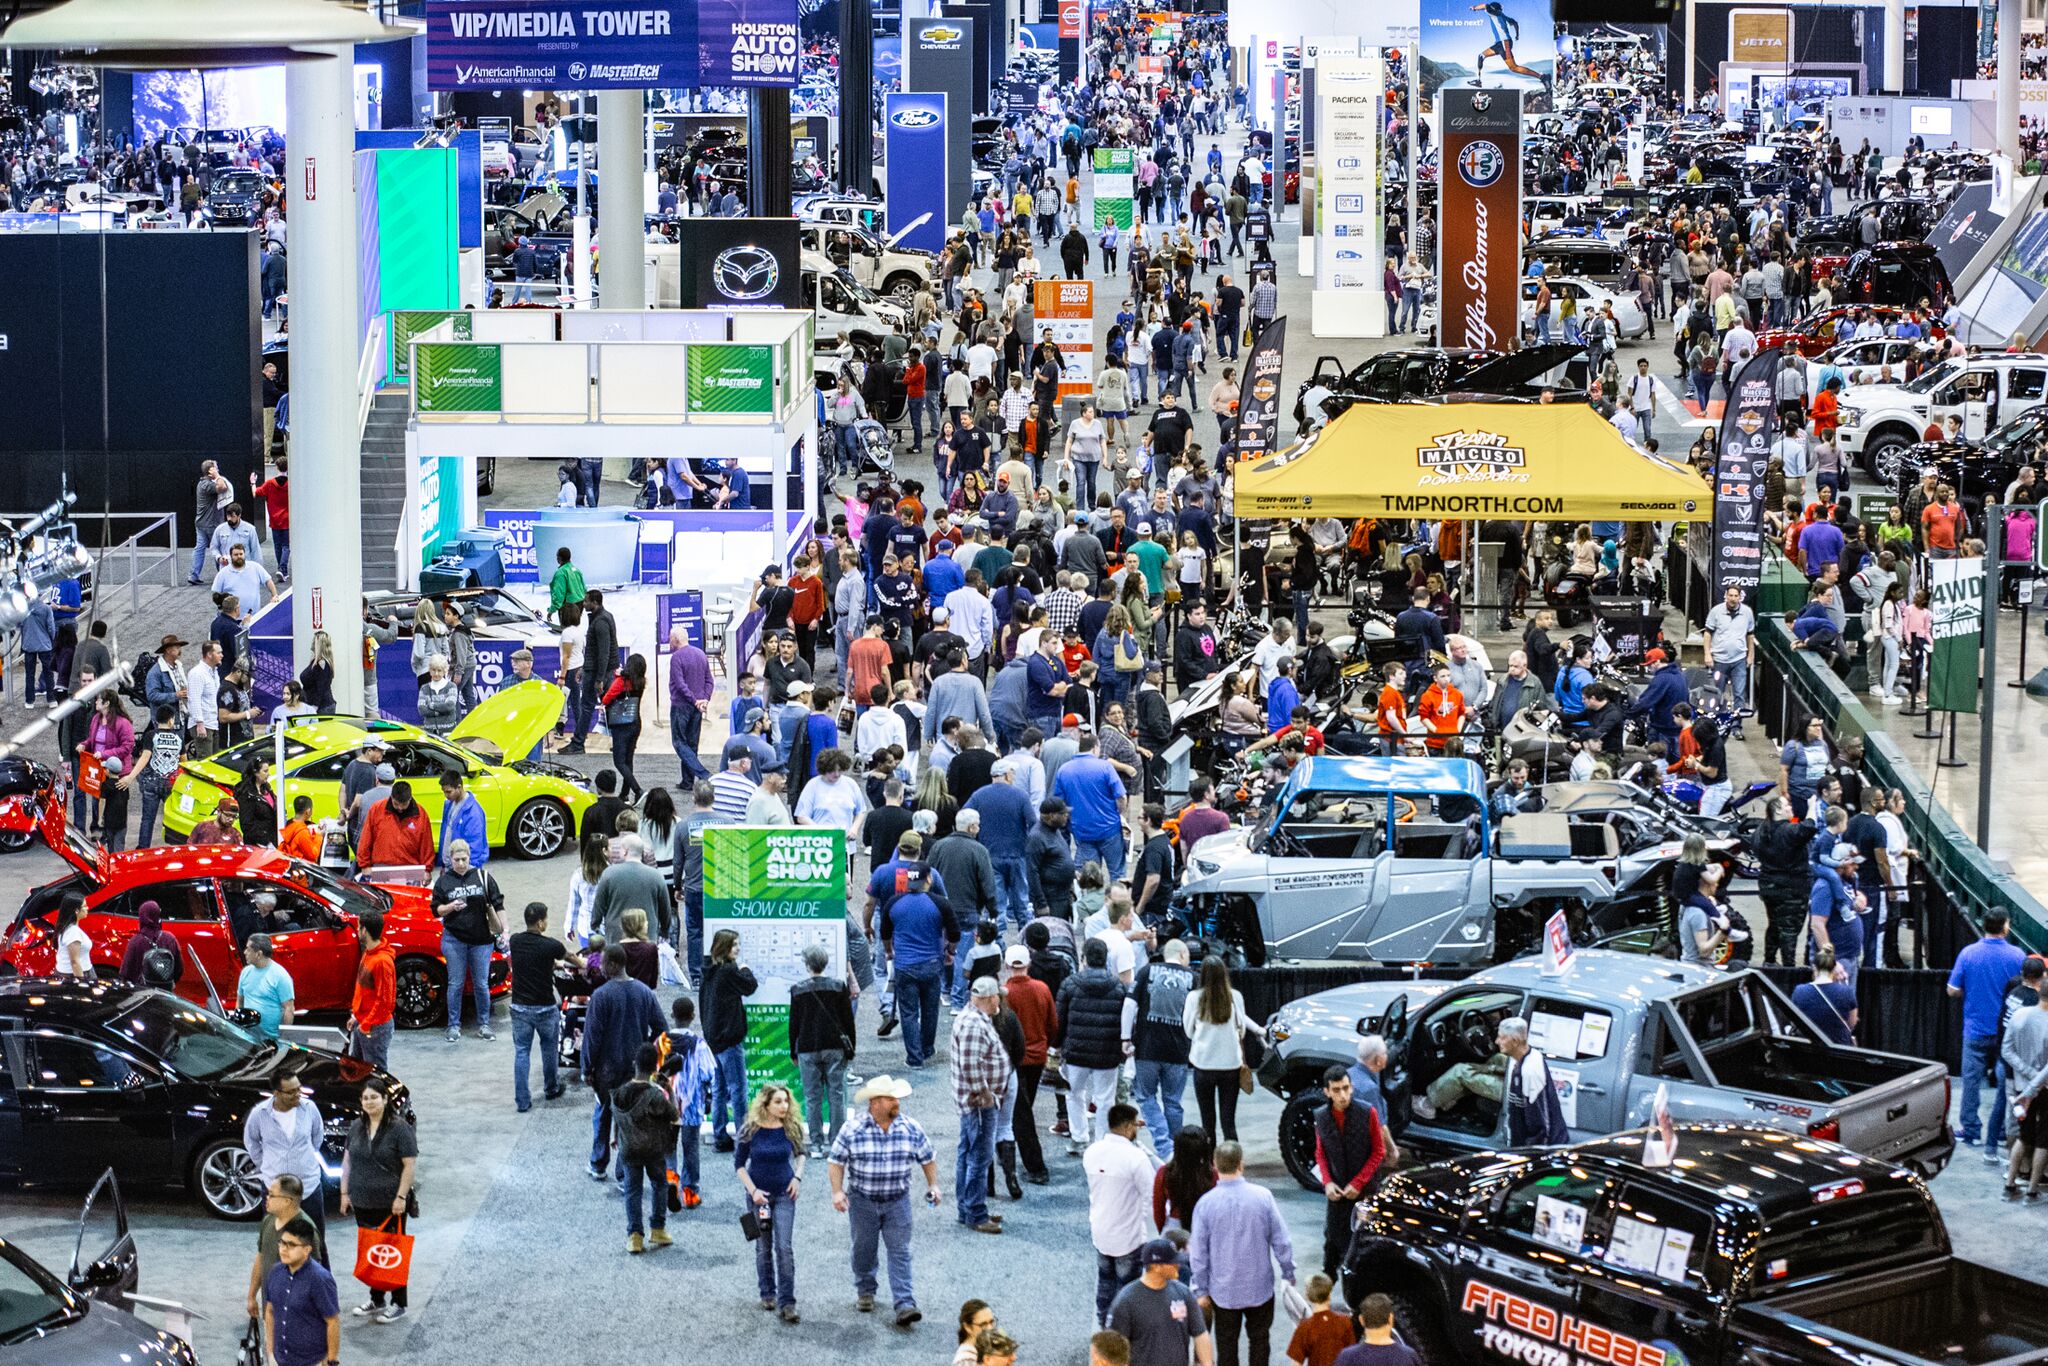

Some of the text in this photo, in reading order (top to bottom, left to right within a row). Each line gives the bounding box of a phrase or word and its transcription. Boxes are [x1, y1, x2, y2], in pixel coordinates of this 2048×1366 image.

[450, 11, 670, 37] VIP/MEDIA TOWER
[732, 24, 796, 36] HOUSTON
[731, 36, 796, 54] AUTO
[1740, 38, 1782, 46] JETTA
[472, 65, 556, 78] AmericanFinancial
[732, 54, 796, 74] SHOW
[899, 110, 931, 125] Ford
[1451, 116, 1511, 130] Alfa Romeo
[1460, 143, 1502, 165] ALFA ROMEO
[1463, 198, 1488, 295] Romeo
[749, 350, 768, 358] 2019
[1442, 432, 1498, 450] TEAM
[1426, 448, 1517, 462] MANCUSO
[1418, 472, 1530, 486] POWERSPORTS
[1381, 495, 1564, 513] TMPNORTH.COM
[504, 531, 534, 548] AU
[1722, 576, 1759, 586] SPYDER
[1932, 576, 1982, 605] 4WD
[1934, 607, 1951, 616] LOW
[1932, 618, 1982, 640] CRAWL
[766, 836, 832, 847] HOUSTON
[767, 848, 833, 864] AUTO
[767, 864, 833, 881] SHOW
[732, 901, 820, 916] SHOW GUIDE
[1482, 1323, 1570, 1366] TOYOTA
